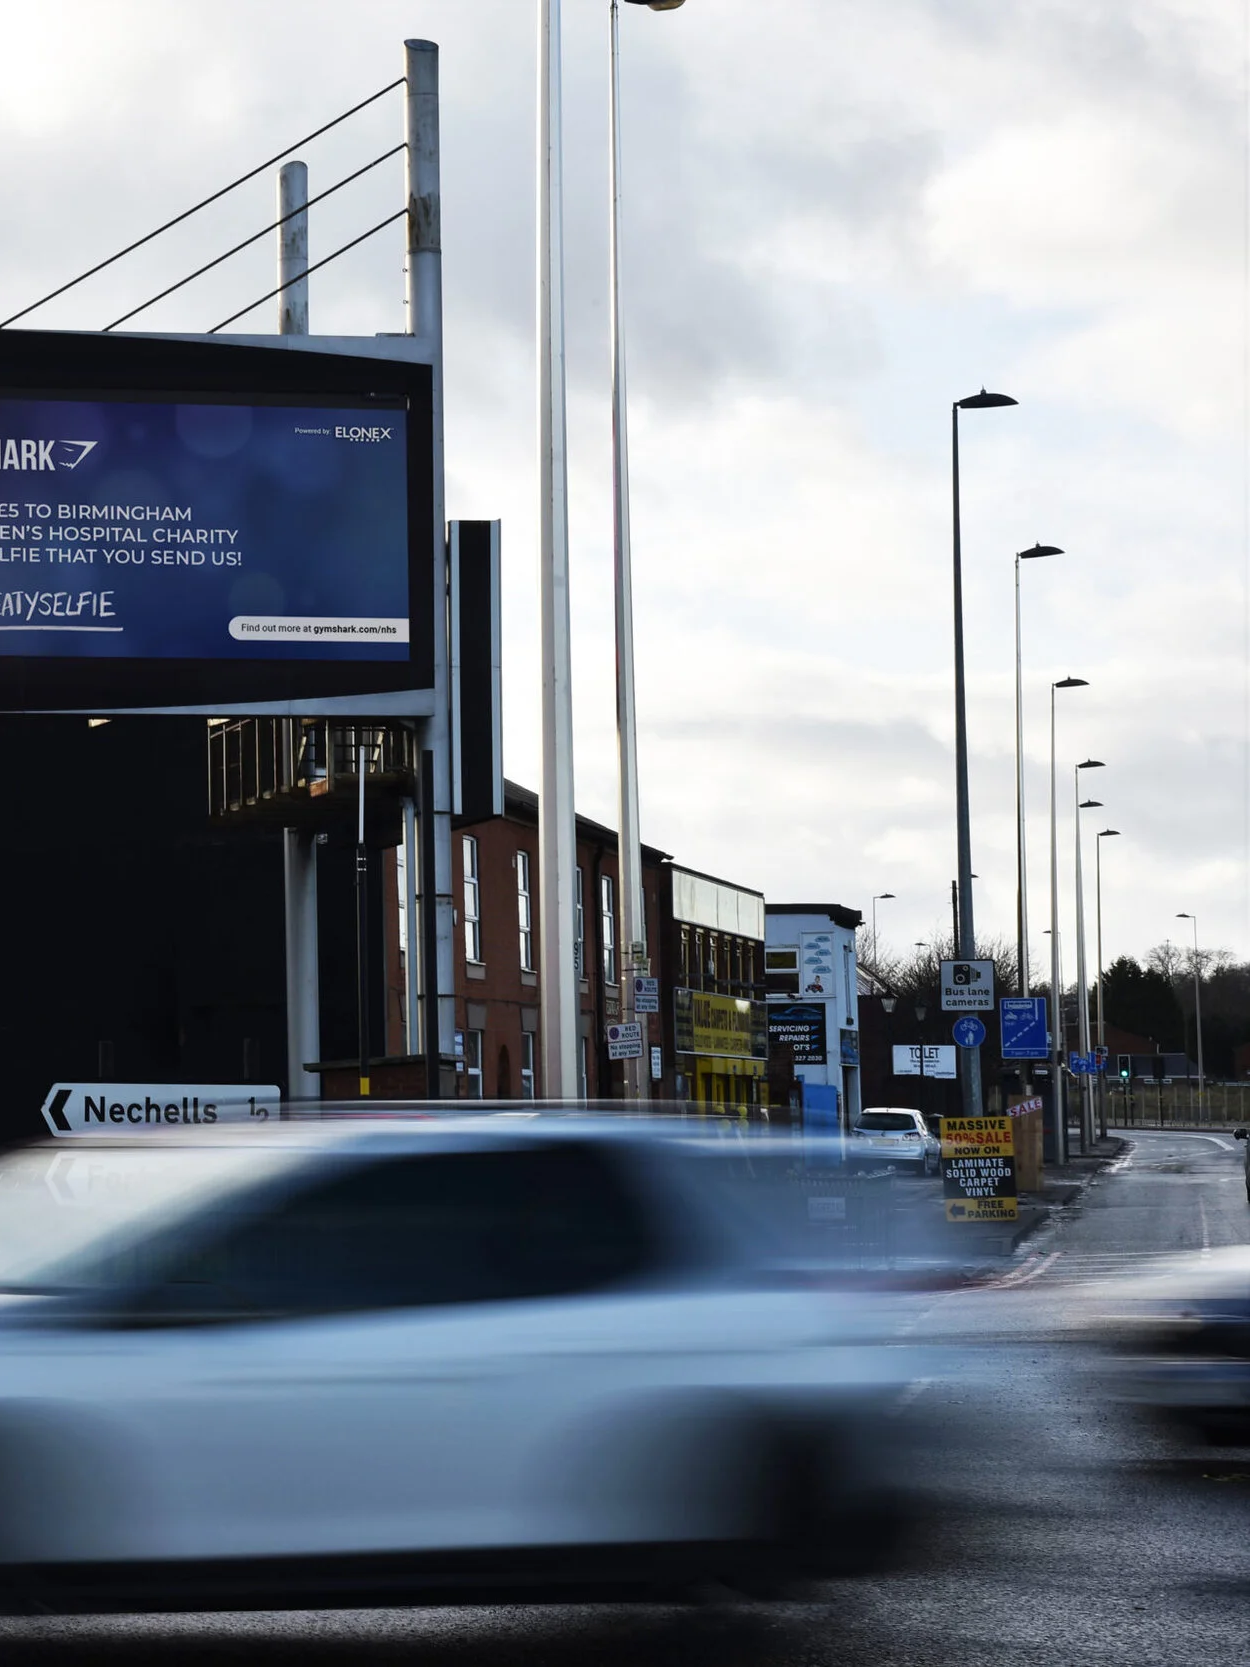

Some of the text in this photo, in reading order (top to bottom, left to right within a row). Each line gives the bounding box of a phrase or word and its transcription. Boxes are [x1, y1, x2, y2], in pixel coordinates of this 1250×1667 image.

[294, 427, 321, 435] Powered
[335, 426, 392, 439] ELONEX
[24, 503, 52, 519] TO
[58, 504, 192, 522] BIRMINGHAM
[49, 526, 148, 543] HOSPITAL
[152, 528, 239, 544] CHARITY
[46, 548, 98, 564] THAT
[102, 549, 145, 565] YOU
[151, 550, 206, 566] SEND
[211, 551, 243, 566] US!
[241, 623, 397, 635] Find out more at gymshark.com/nhs
[945, 988, 990, 996] Bus lane
[946, 999, 990, 1007] cameras
[768, 1025, 810, 1033] SERVICING
[909, 1047, 939, 1059] TO LET
[84, 1096, 218, 1125] Nechells
[1010, 1097, 1041, 1117] SALE
[947, 1120, 1006, 1131] MASSIVE
[954, 1146, 1000, 1155] NOW ON
[952, 1158, 1004, 1169] LAMINATE
[946, 1168, 1011, 1178] SOLID WOOD
[959, 1178, 1000, 1188] CARPET
[965, 1187, 996, 1197] VINYL
[977, 1200, 1004, 1209] FREE
[967, 1209, 1016, 1218] PARKING
